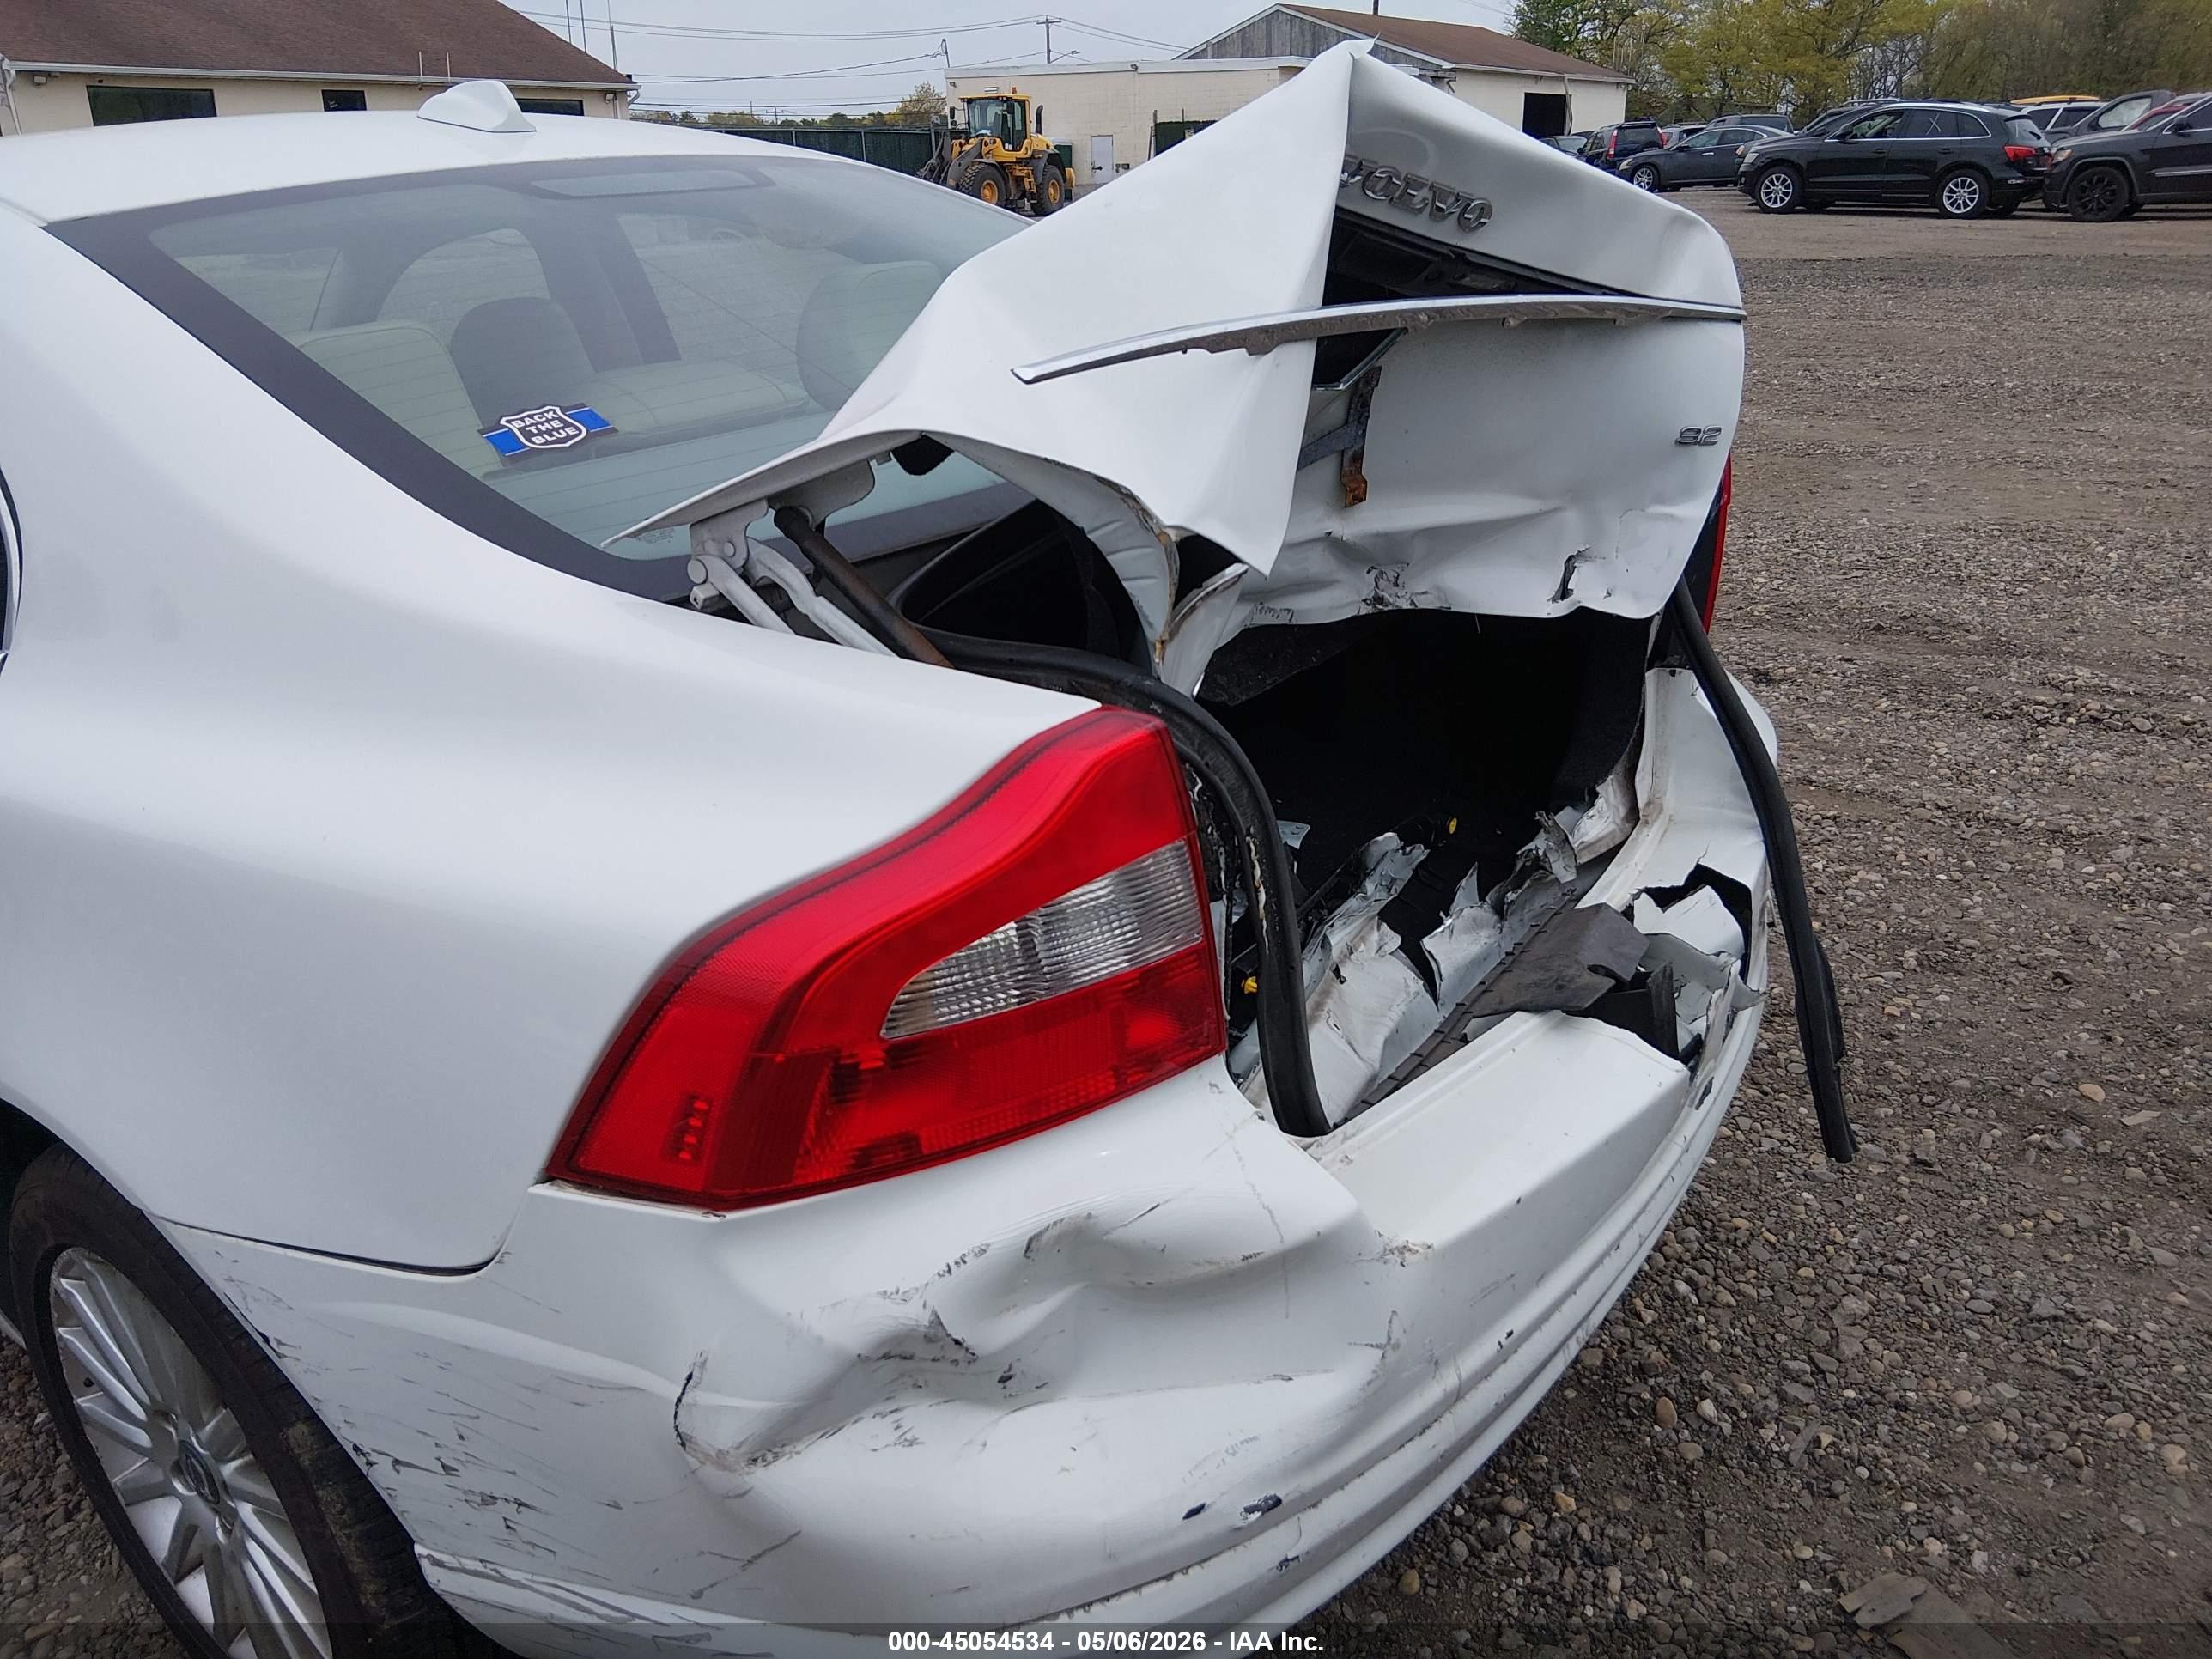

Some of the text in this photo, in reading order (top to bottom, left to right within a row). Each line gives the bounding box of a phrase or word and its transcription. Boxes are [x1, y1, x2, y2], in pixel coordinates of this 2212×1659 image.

[1340, 155, 1493, 234] VOLVO
[511, 411, 559, 428] BACK
[526, 420, 564, 434] THE
[531, 427, 579, 445] BLUE
